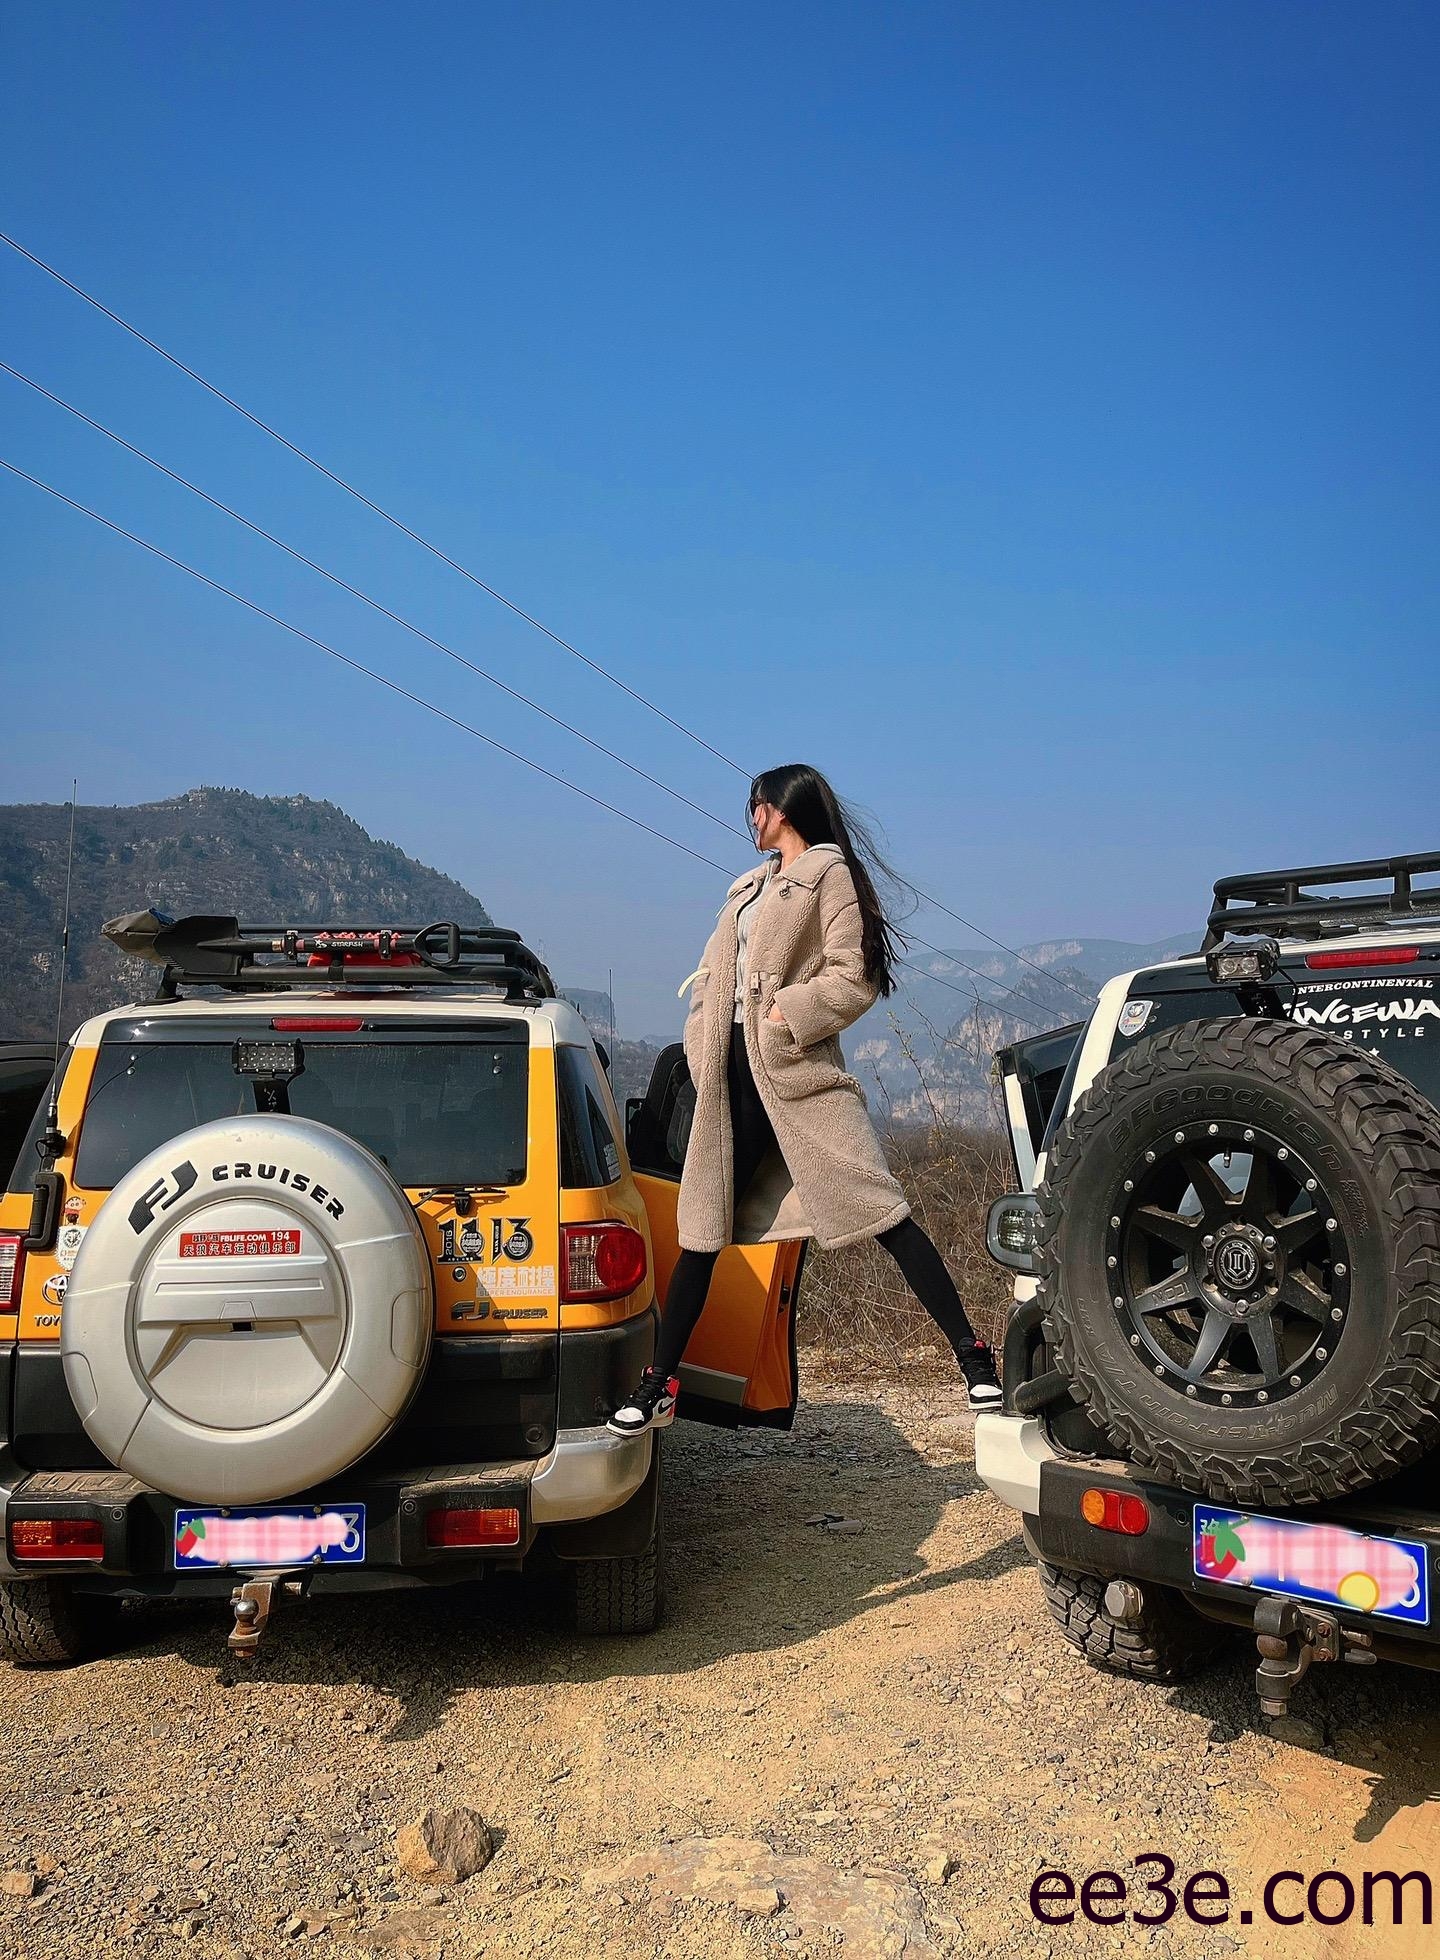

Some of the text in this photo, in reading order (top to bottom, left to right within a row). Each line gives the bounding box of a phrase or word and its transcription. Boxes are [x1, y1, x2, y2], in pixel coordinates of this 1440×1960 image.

[1328, 1026, 1425, 1040] STYLE
[1107, 1084, 1344, 1172] BFGoodrich
[128, 1160, 345, 1235] FJ CRUISER
[220, 1233, 267, 1243] FBLIFE.COM
[271, 1231, 290, 1241] 194
[184, 1241, 295, 1257] 天狼汽车运动俱乐部
